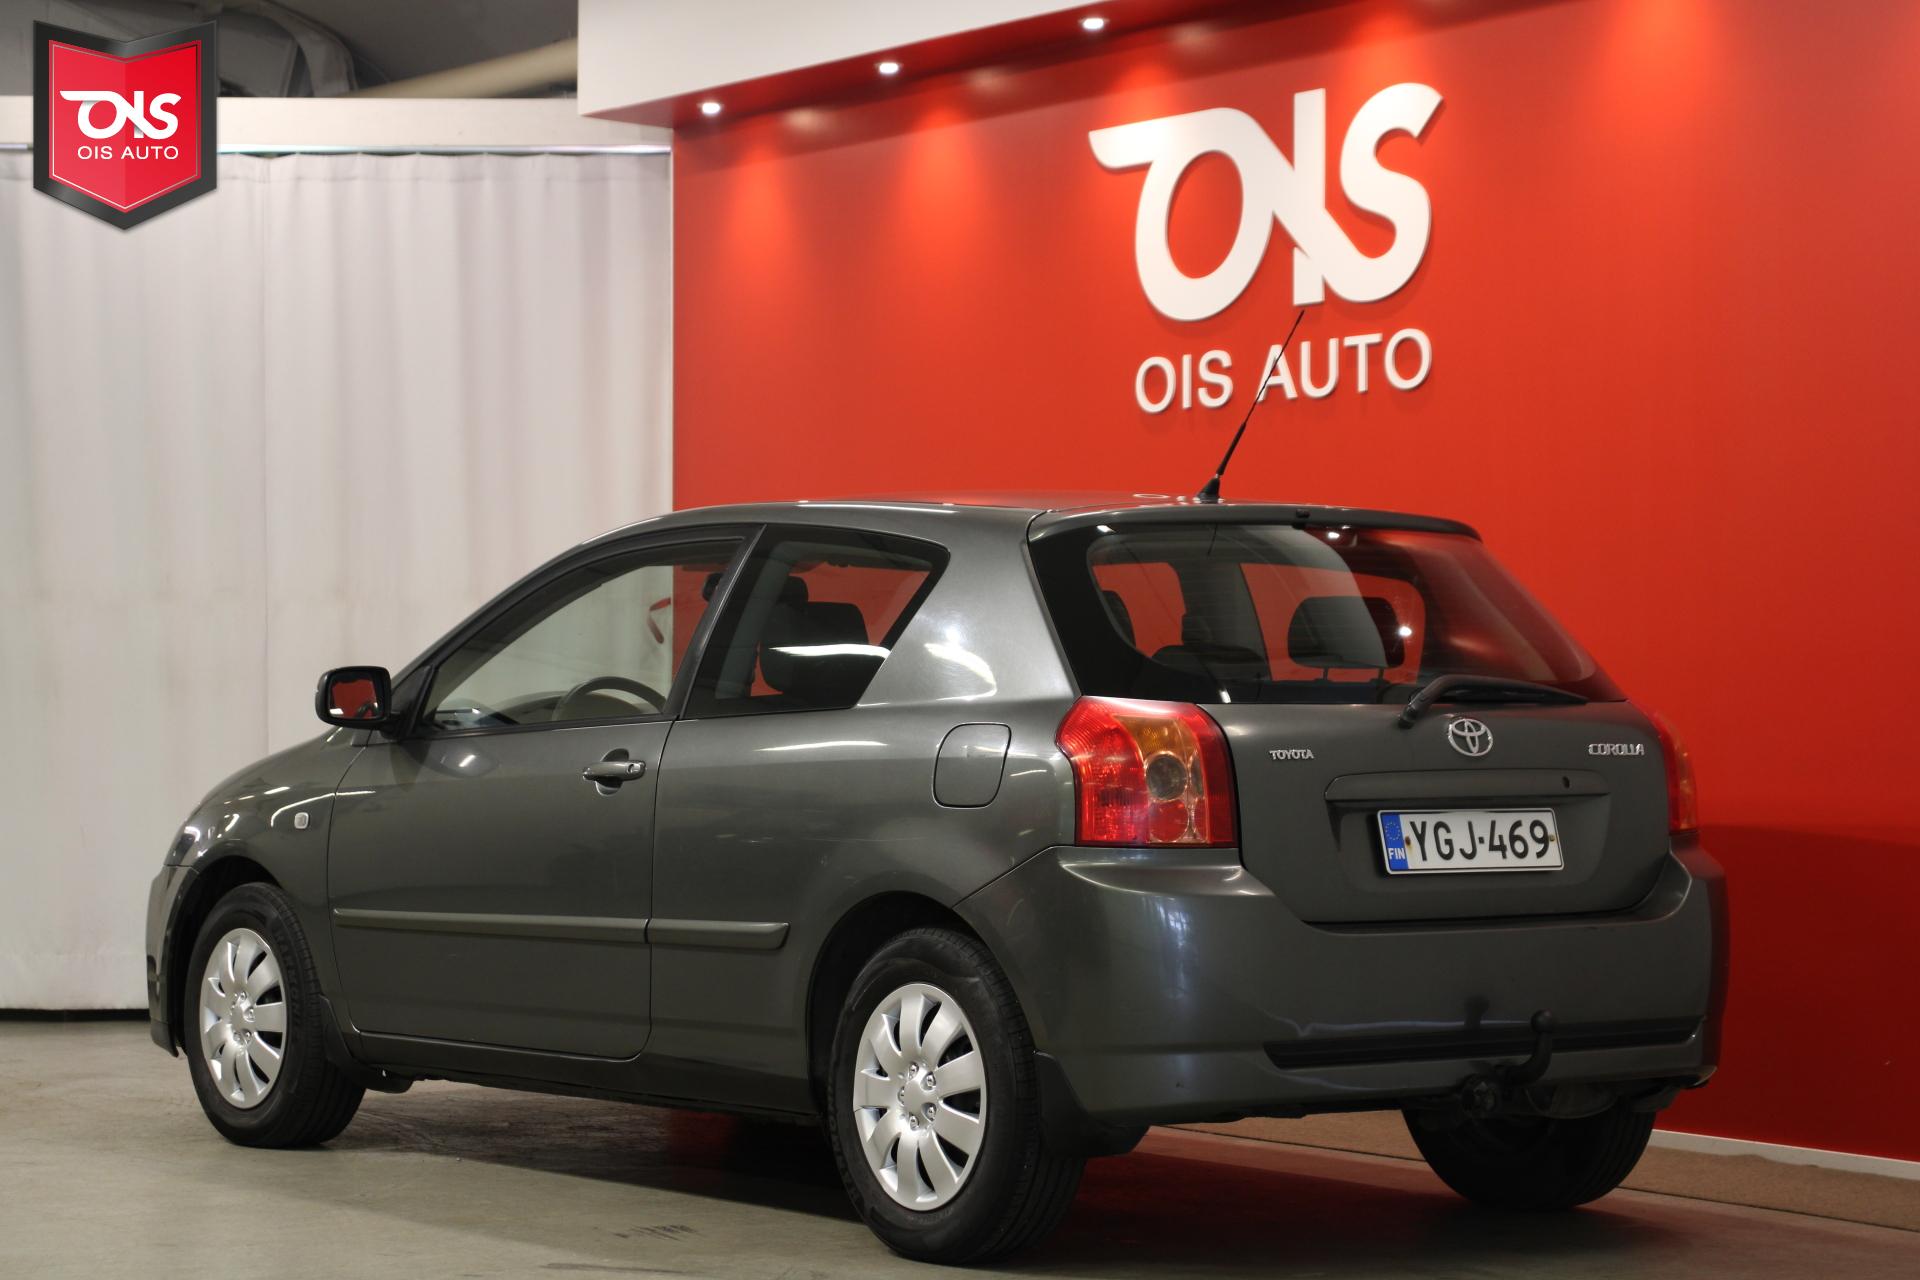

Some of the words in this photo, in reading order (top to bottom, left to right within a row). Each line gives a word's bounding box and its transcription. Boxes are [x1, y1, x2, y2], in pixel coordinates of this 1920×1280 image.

[1135, 349, 1233, 414] OIS
[1255, 328, 1432, 402] AUTO
[1269, 749, 1314, 760] TOYOTA
[1588, 743, 1645, 756] COROLLA
[1409, 819, 1550, 862] YGJ-469
[1388, 847, 1406, 860] FIN
